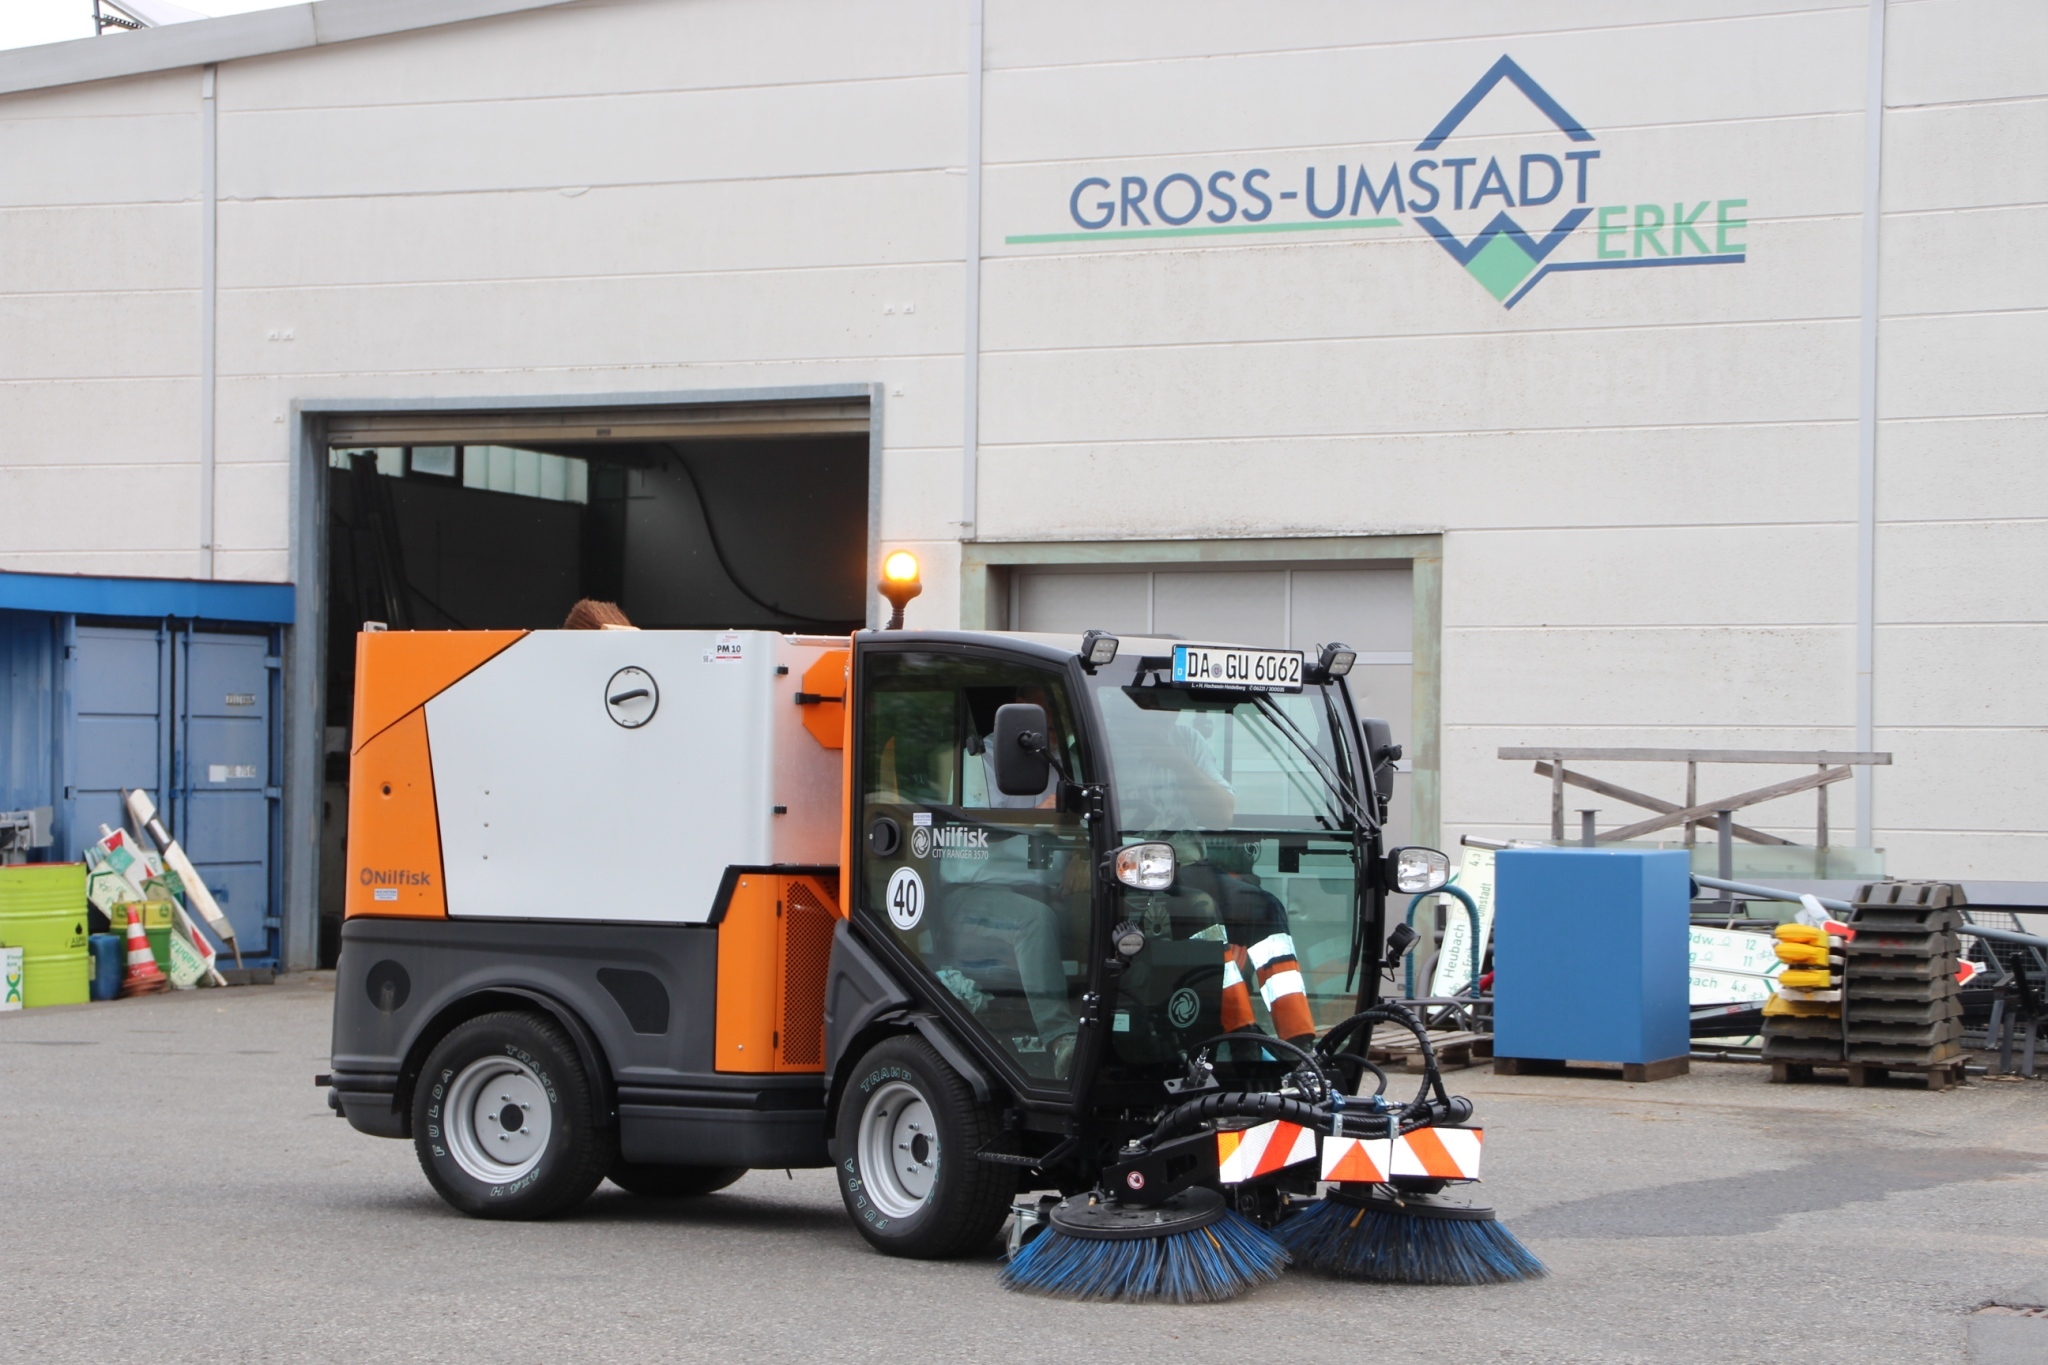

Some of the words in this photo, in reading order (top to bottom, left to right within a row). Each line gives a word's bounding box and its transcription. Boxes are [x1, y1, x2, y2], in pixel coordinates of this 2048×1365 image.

[1069, 150, 1600, 231] GROSS-UMSTADT
[716, 645, 729, 653] PM
[732, 645, 741, 653] 10
[1187, 652, 1210, 678] DA
[1226, 654, 1249, 680] GU
[1254, 656, 1300, 683] 6062
[932, 826, 989, 848] Nilfisk
[932, 848, 946, 859] CITY
[946, 849, 973, 859] RANGER
[973, 850, 989, 860] 3570
[374, 870, 431, 886] Nilfisk
[893, 879, 918, 918] 40
[1443, 924, 1466, 979] Heubach
[1745, 939, 1757, 951] 12
[1743, 956, 1753, 967] 11
[1689, 976, 1718, 988] ach
[504, 1044, 558, 1104] TRAMP
[860, 1066, 912, 1093] TRAMP
[428, 1068, 454, 1158] FULDA
[844, 1157, 890, 1230] FULDA
